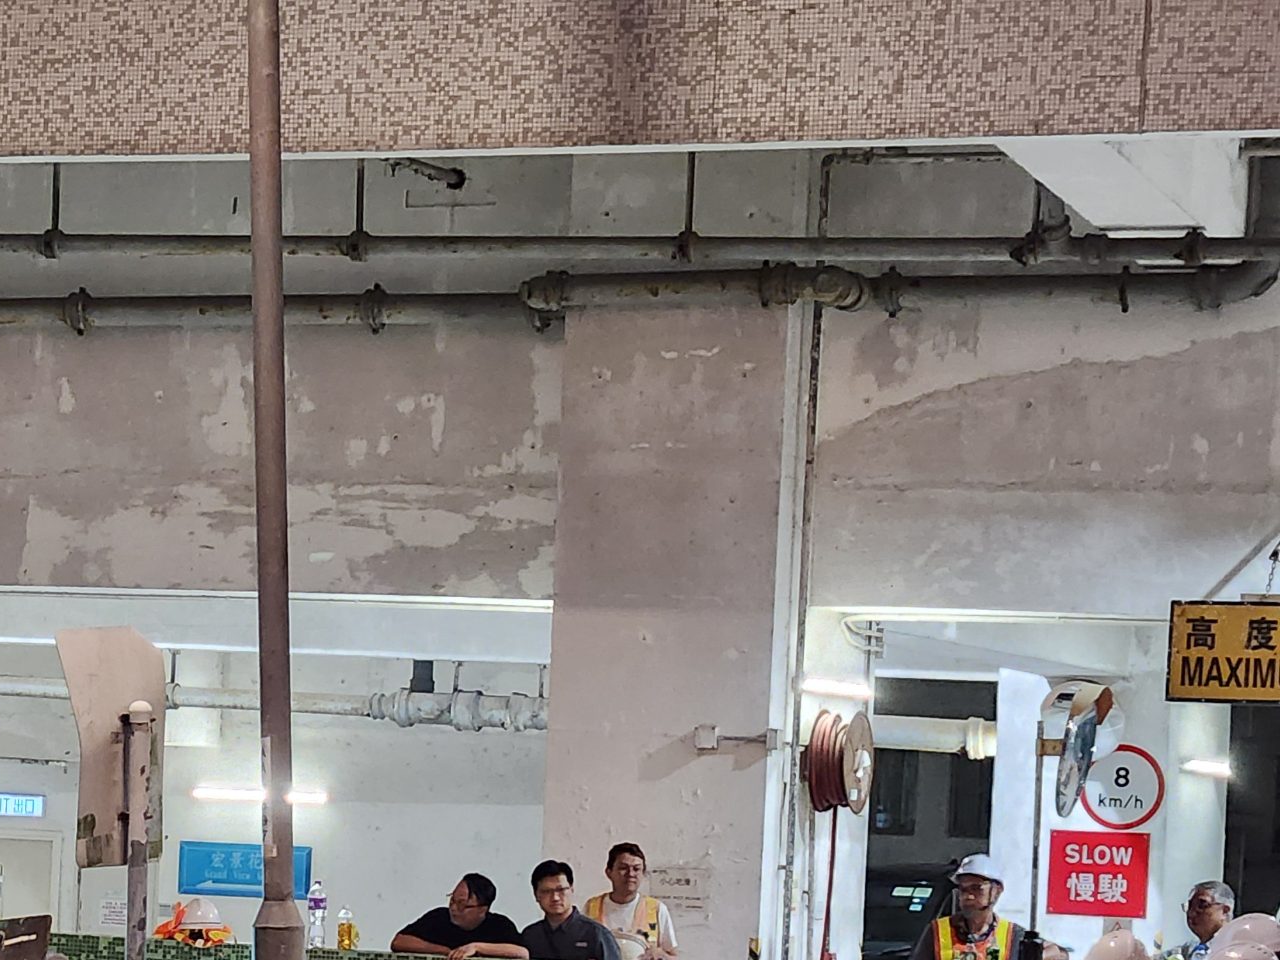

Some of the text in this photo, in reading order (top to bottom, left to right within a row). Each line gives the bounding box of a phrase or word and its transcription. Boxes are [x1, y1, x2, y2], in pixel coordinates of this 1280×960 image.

[1185, 616, 1278, 652] 高度
[1114, 766, 1130, 788] 8
[13, 798, 35, 814] 出口
[1098, 794, 1144, 810] km/h
[210, 851, 264, 869] 宏景花
[1064, 843, 1133, 866] SLOW
[1066, 872, 1128, 904] 慢駛
